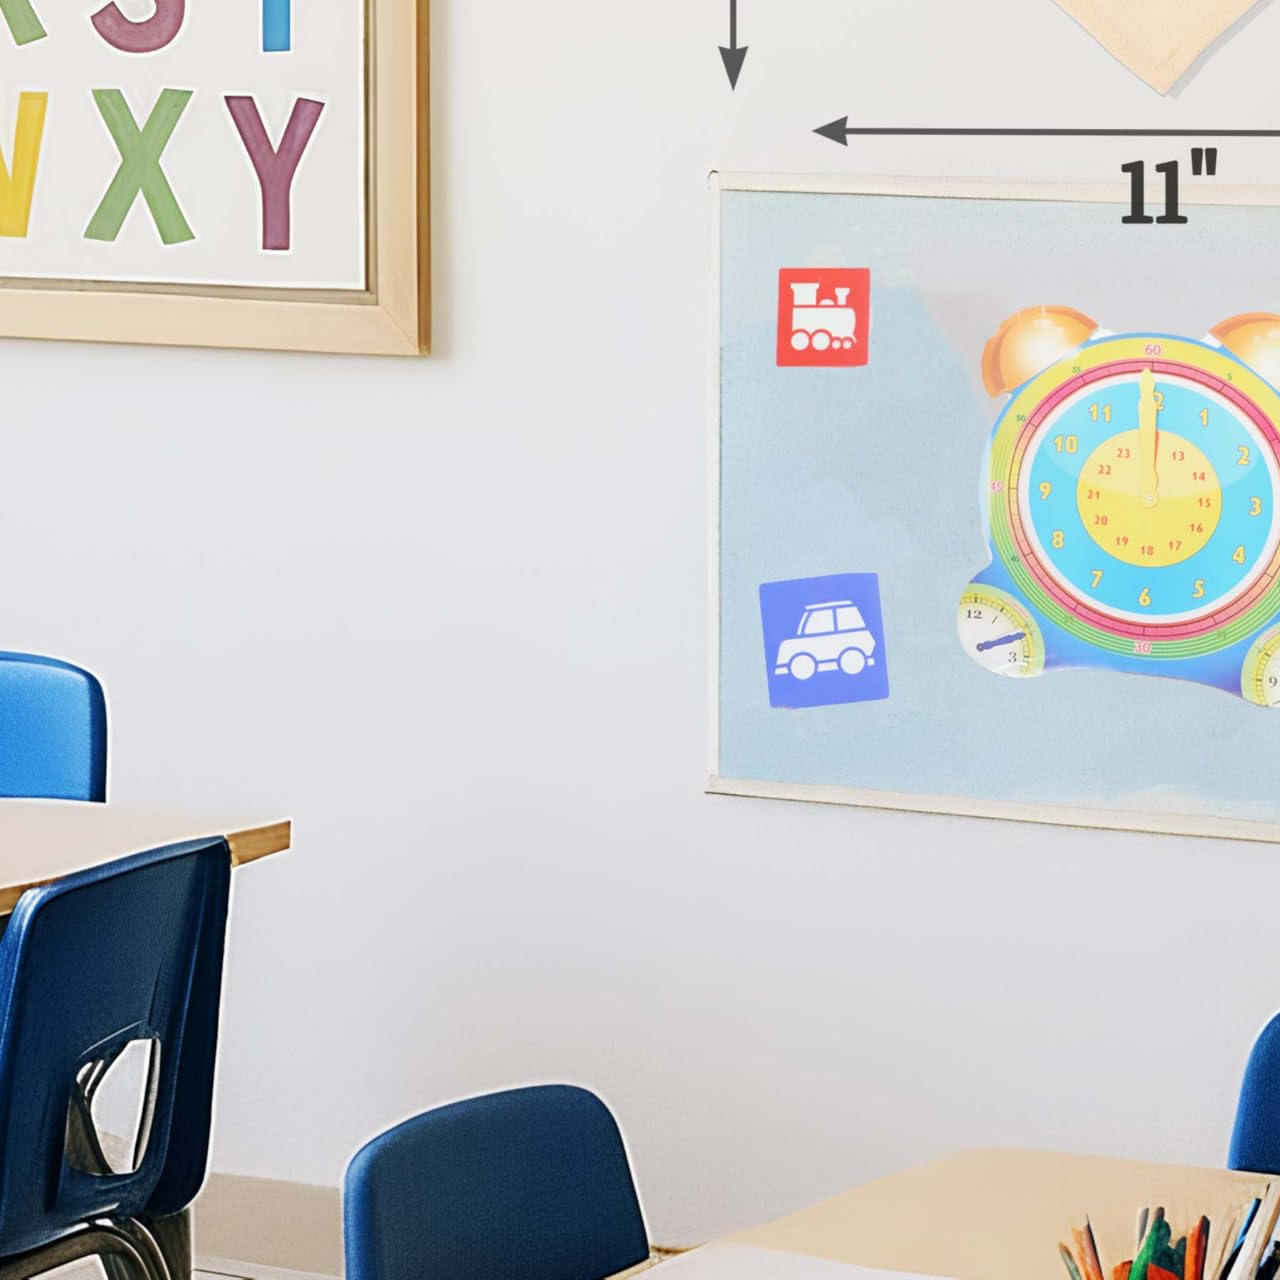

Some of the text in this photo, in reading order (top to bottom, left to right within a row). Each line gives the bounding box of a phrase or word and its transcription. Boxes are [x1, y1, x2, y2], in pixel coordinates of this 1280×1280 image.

[84, 88, 196, 245] X
[224, 96, 325, 250] Y
[1144, 344, 1161, 356] 60
[1088, 403, 1112, 423] 11
[1200, 408, 1209, 427] 1
[1054, 434, 1078, 454] 10
[1116, 448, 1131, 459] 23
[1172, 451, 1185, 461] 13
[1236, 445, 1250, 465] 2
[1098, 464, 1112, 475] 22
[1192, 472, 1206, 481] 14
[1039, 481, 1052, 500] 9
[1087, 490, 1101, 499] 21
[1198, 498, 1211, 508] 15
[1248, 496, 1262, 516] 3
[1094, 515, 1108, 525] 20
[1190, 523, 1203, 533] 16
[1052, 530, 1065, 549] 8
[1115, 536, 1129, 546] 19
[1140, 546, 1154, 556] 18
[1168, 541, 1182, 551] 17
[1232, 545, 1246, 565] 4
[1090, 570, 1104, 589] 7
[1192, 578, 1205, 598] 5
[1138, 587, 1152, 607] 6
[967, 608, 982, 619] 12
[1135, 641, 1152, 653] 30
[1008, 651, 1017, 663] 3
[1268, 676, 1278, 688] 9
